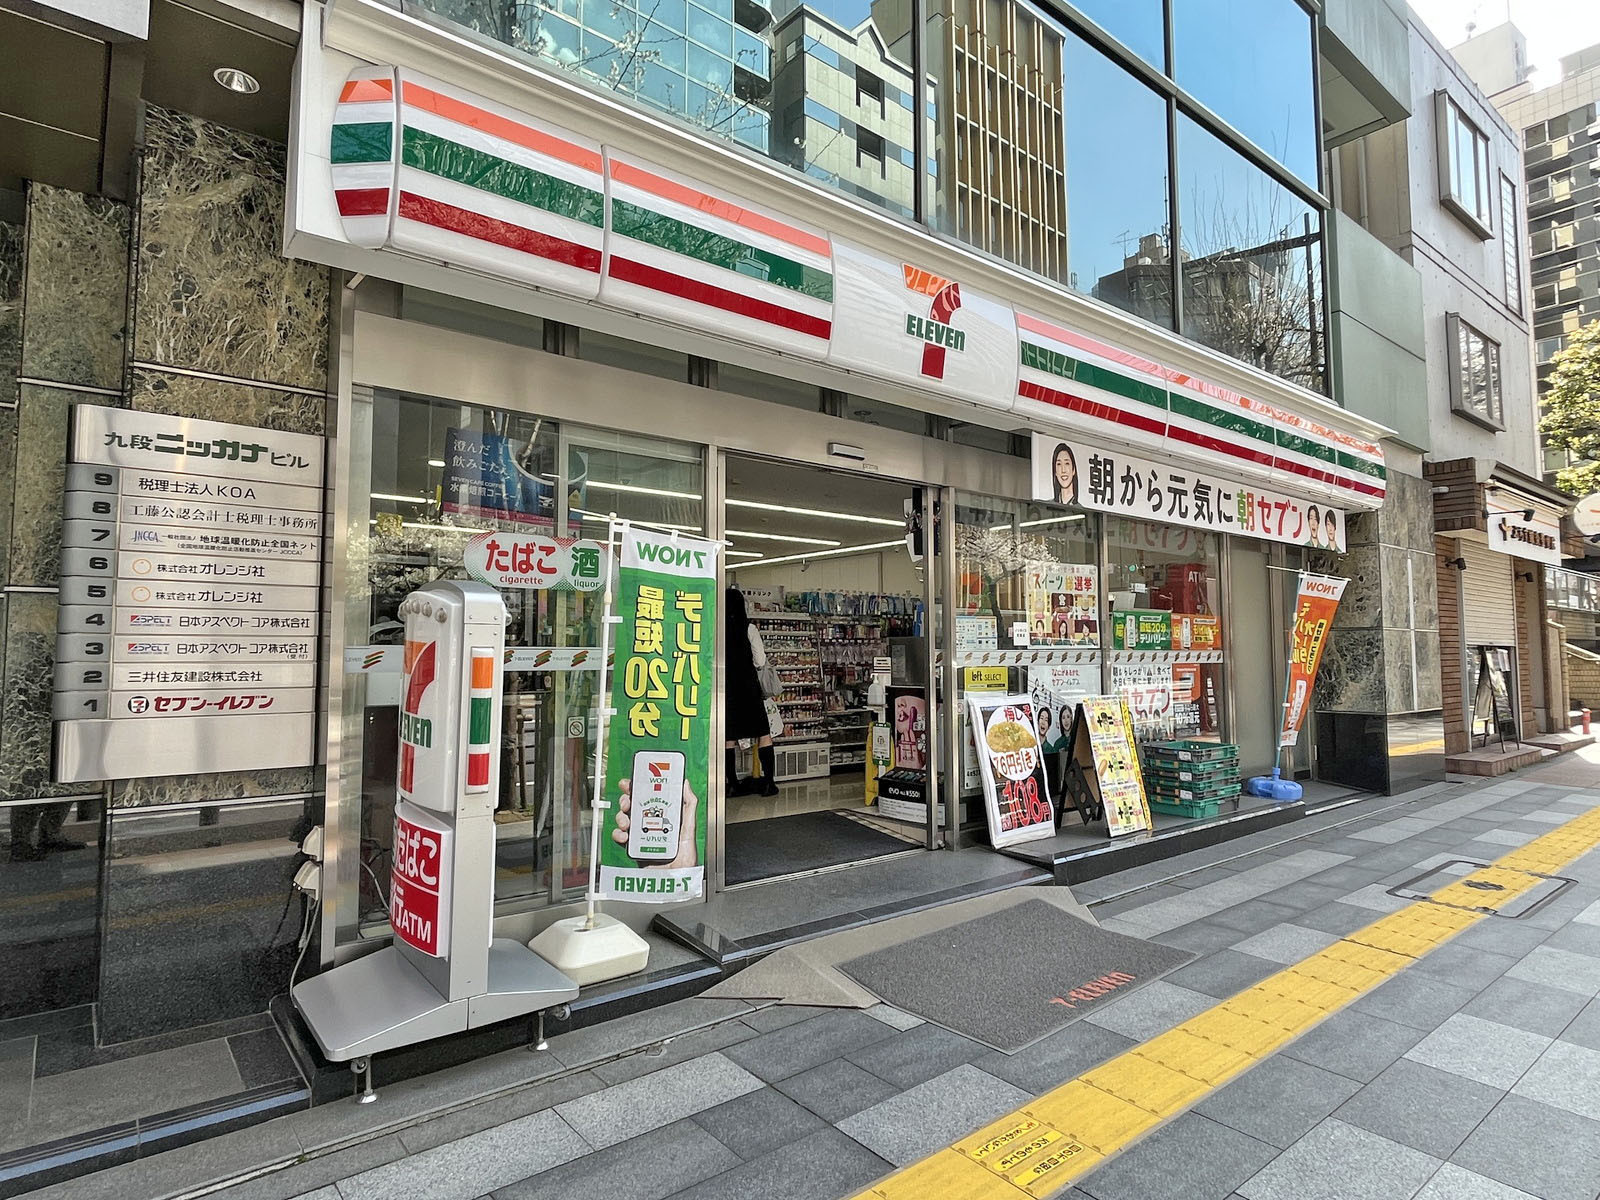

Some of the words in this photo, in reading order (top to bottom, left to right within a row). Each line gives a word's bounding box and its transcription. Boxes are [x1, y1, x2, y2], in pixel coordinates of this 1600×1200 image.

[104, 432, 309, 468] 九段ニッカナビル
[453, 439, 491, 456] 澄んだ
[94, 473, 112, 486] 9
[138, 477, 256, 500] 税理士法人KOA
[1088, 453, 1302, 538] 朝から元気に朝セブン
[92, 501, 110, 514] 8
[130, 503, 318, 530] 工藤公認会計士税理士事務所
[90, 529, 111, 541] 7
[200, 534, 317, 550] 地球温暖化防止全国ネット
[89, 557, 108, 570] 6
[157, 563, 265, 577] 株式会社オレンジ社
[485, 539, 558, 575] たばこ
[571, 547, 599, 578] 酒
[499, 575, 543, 586] cigarette
[574, 579, 600, 589] liquor
[87, 586, 106, 598] 5
[156, 590, 263, 603] 株式会社オレンジ社
[85, 613, 105, 625] 4
[179, 616, 310, 628] 日本アスペクトコア株式会社
[85, 642, 104, 655] 3
[176, 643, 308, 655] 日本アスペクトコア株式会社
[83, 671, 102, 684] 2
[128, 670, 263, 683] 三井住友建設株式会社
[83, 698, 98, 711] 1
[154, 695, 274, 711] セブン-イレブン
[390, 877, 431, 943] 行ATM
